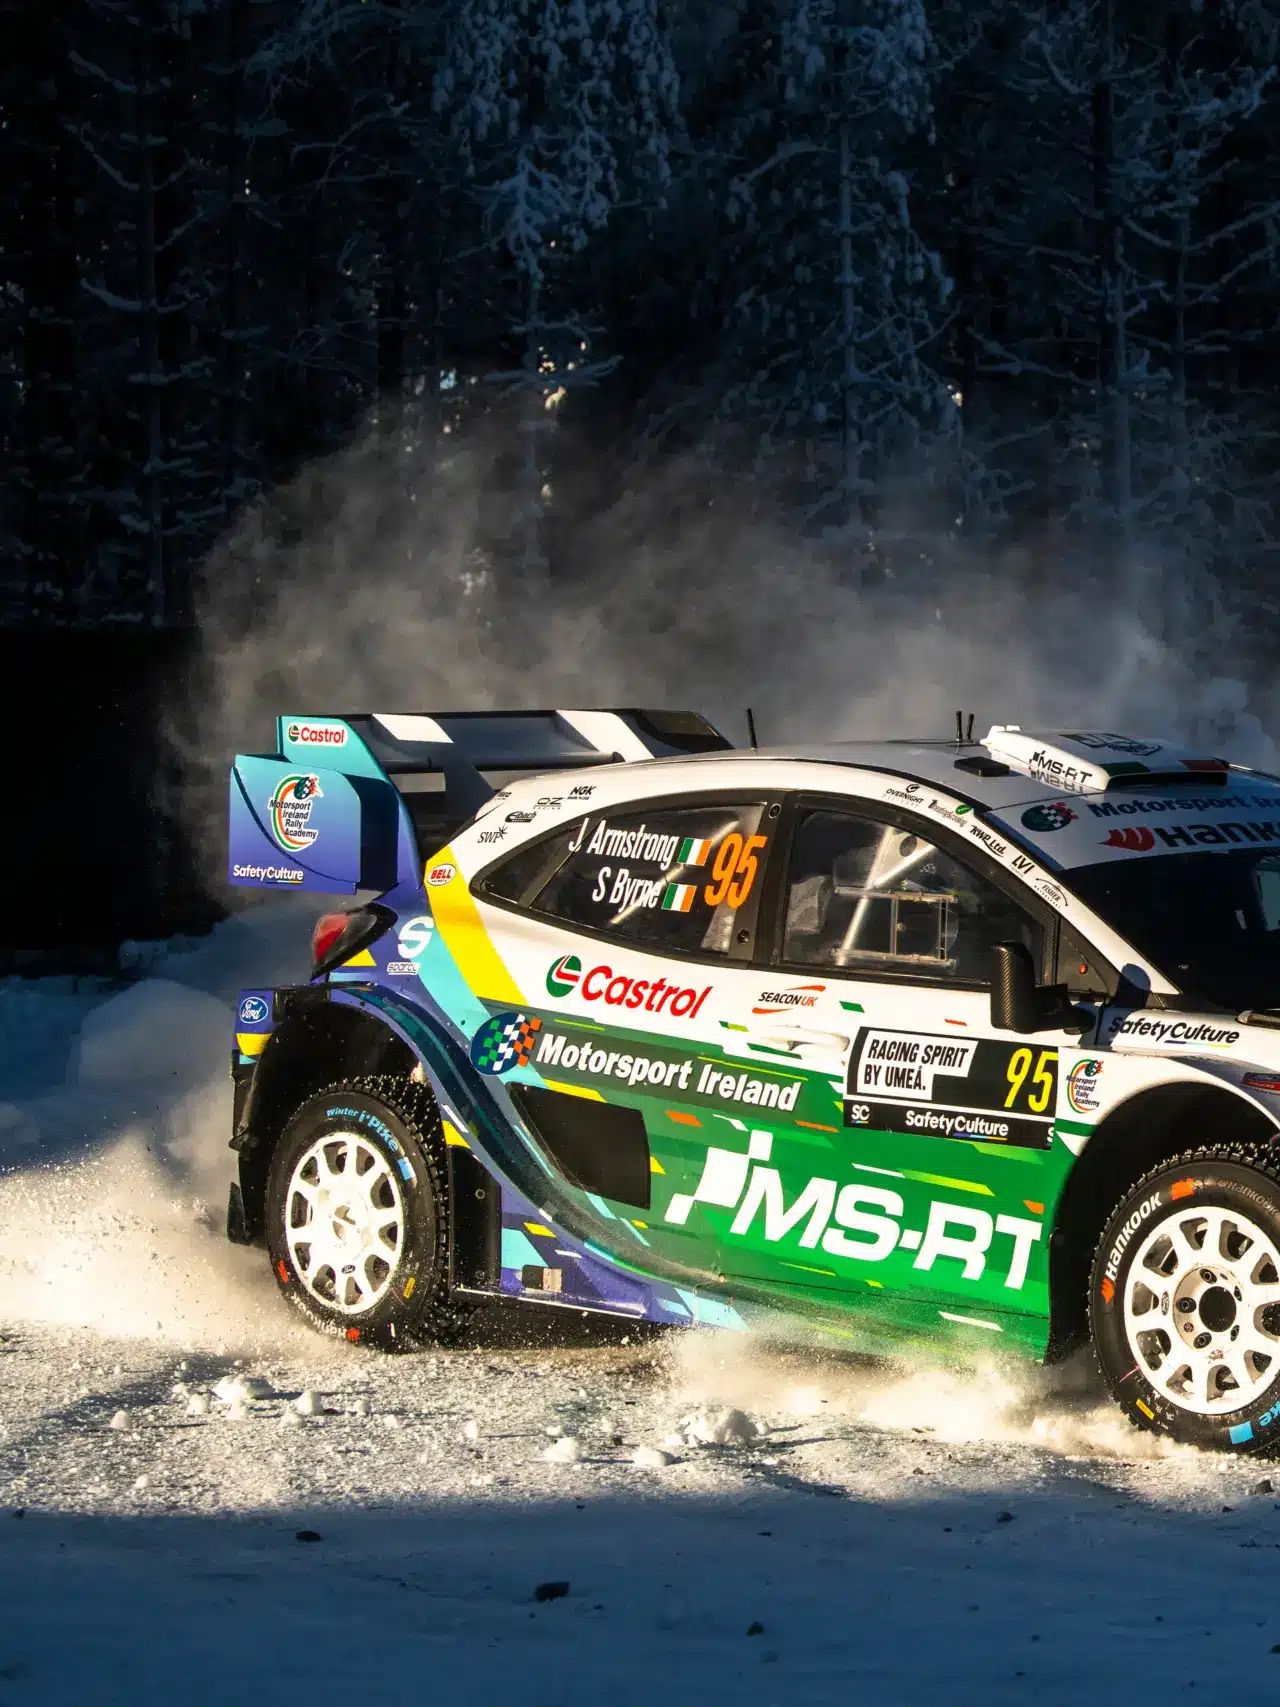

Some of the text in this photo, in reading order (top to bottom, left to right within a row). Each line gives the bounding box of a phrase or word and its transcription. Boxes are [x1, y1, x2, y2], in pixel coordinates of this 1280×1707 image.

[300, 726, 345, 744] Castrol
[1037, 755, 1093, 784] MS-RT
[569, 785, 597, 796] NGK
[885, 788, 925, 804] OVERNIGHT
[269, 799, 312, 812] Motorsport
[537, 797, 564, 805] OZ
[1087, 795, 1248, 818] Motorsport
[282, 809, 310, 820] Ireland
[284, 818, 304, 829] Rally
[504, 810, 537, 823] Eibach
[283, 827, 318, 839] Academy
[477, 831, 501, 844] SWP
[568, 817, 680, 872] J Armstrong
[232, 864, 304, 881] SafetyCulture
[703, 832, 768, 910] 95
[1011, 854, 1036, 875] LVI
[430, 868, 452, 880] BELL
[591, 866, 661, 914] S Byrne
[1041, 884, 1061, 902] FISHER
[580, 964, 716, 1020] Castrol
[241, 999, 263, 1020] Ford
[1107, 1016, 1240, 1044] SafetyCulture
[866, 1038, 969, 1068] RACING SPIRIT
[535, 1032, 803, 1113] Motorsport Ireland
[863, 1063, 927, 1091] BY UMEÅ.
[1003, 1047, 1058, 1113] 95
[1065, 1074, 1098, 1086] Motorsport
[1073, 1083, 1095, 1093] Ireland
[1075, 1090, 1090, 1100] Rally
[1073, 1097, 1101, 1108] Academy
[851, 1104, 870, 1121] SC
[905, 1109, 1010, 1137] SafetyCulture
[730, 1164, 1045, 1291] MS-RT
